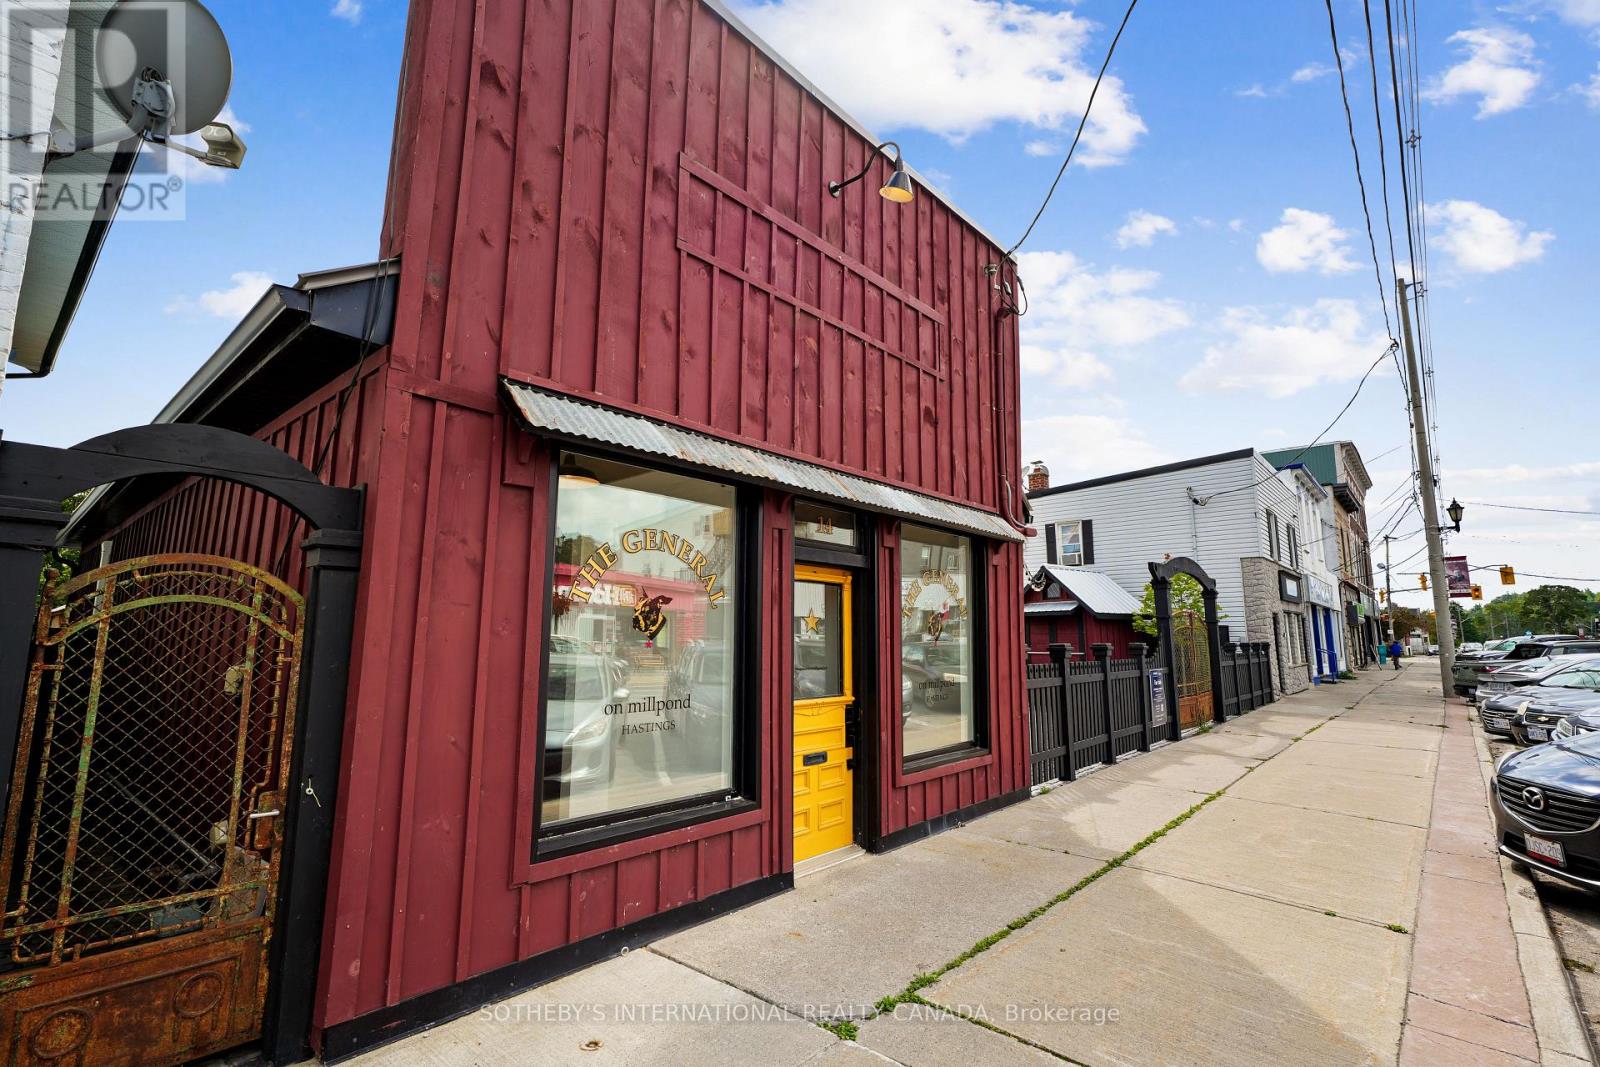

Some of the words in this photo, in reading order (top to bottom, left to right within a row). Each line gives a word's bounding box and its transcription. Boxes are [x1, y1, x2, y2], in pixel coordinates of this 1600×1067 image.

[816, 515, 833, 535] 14
[568, 542, 619, 603] THE
[622, 528, 727, 609] GENERAL
[604, 703, 623, 716] on
[628, 694, 691, 716] millpond
[621, 720, 677, 735] HASTINGS
